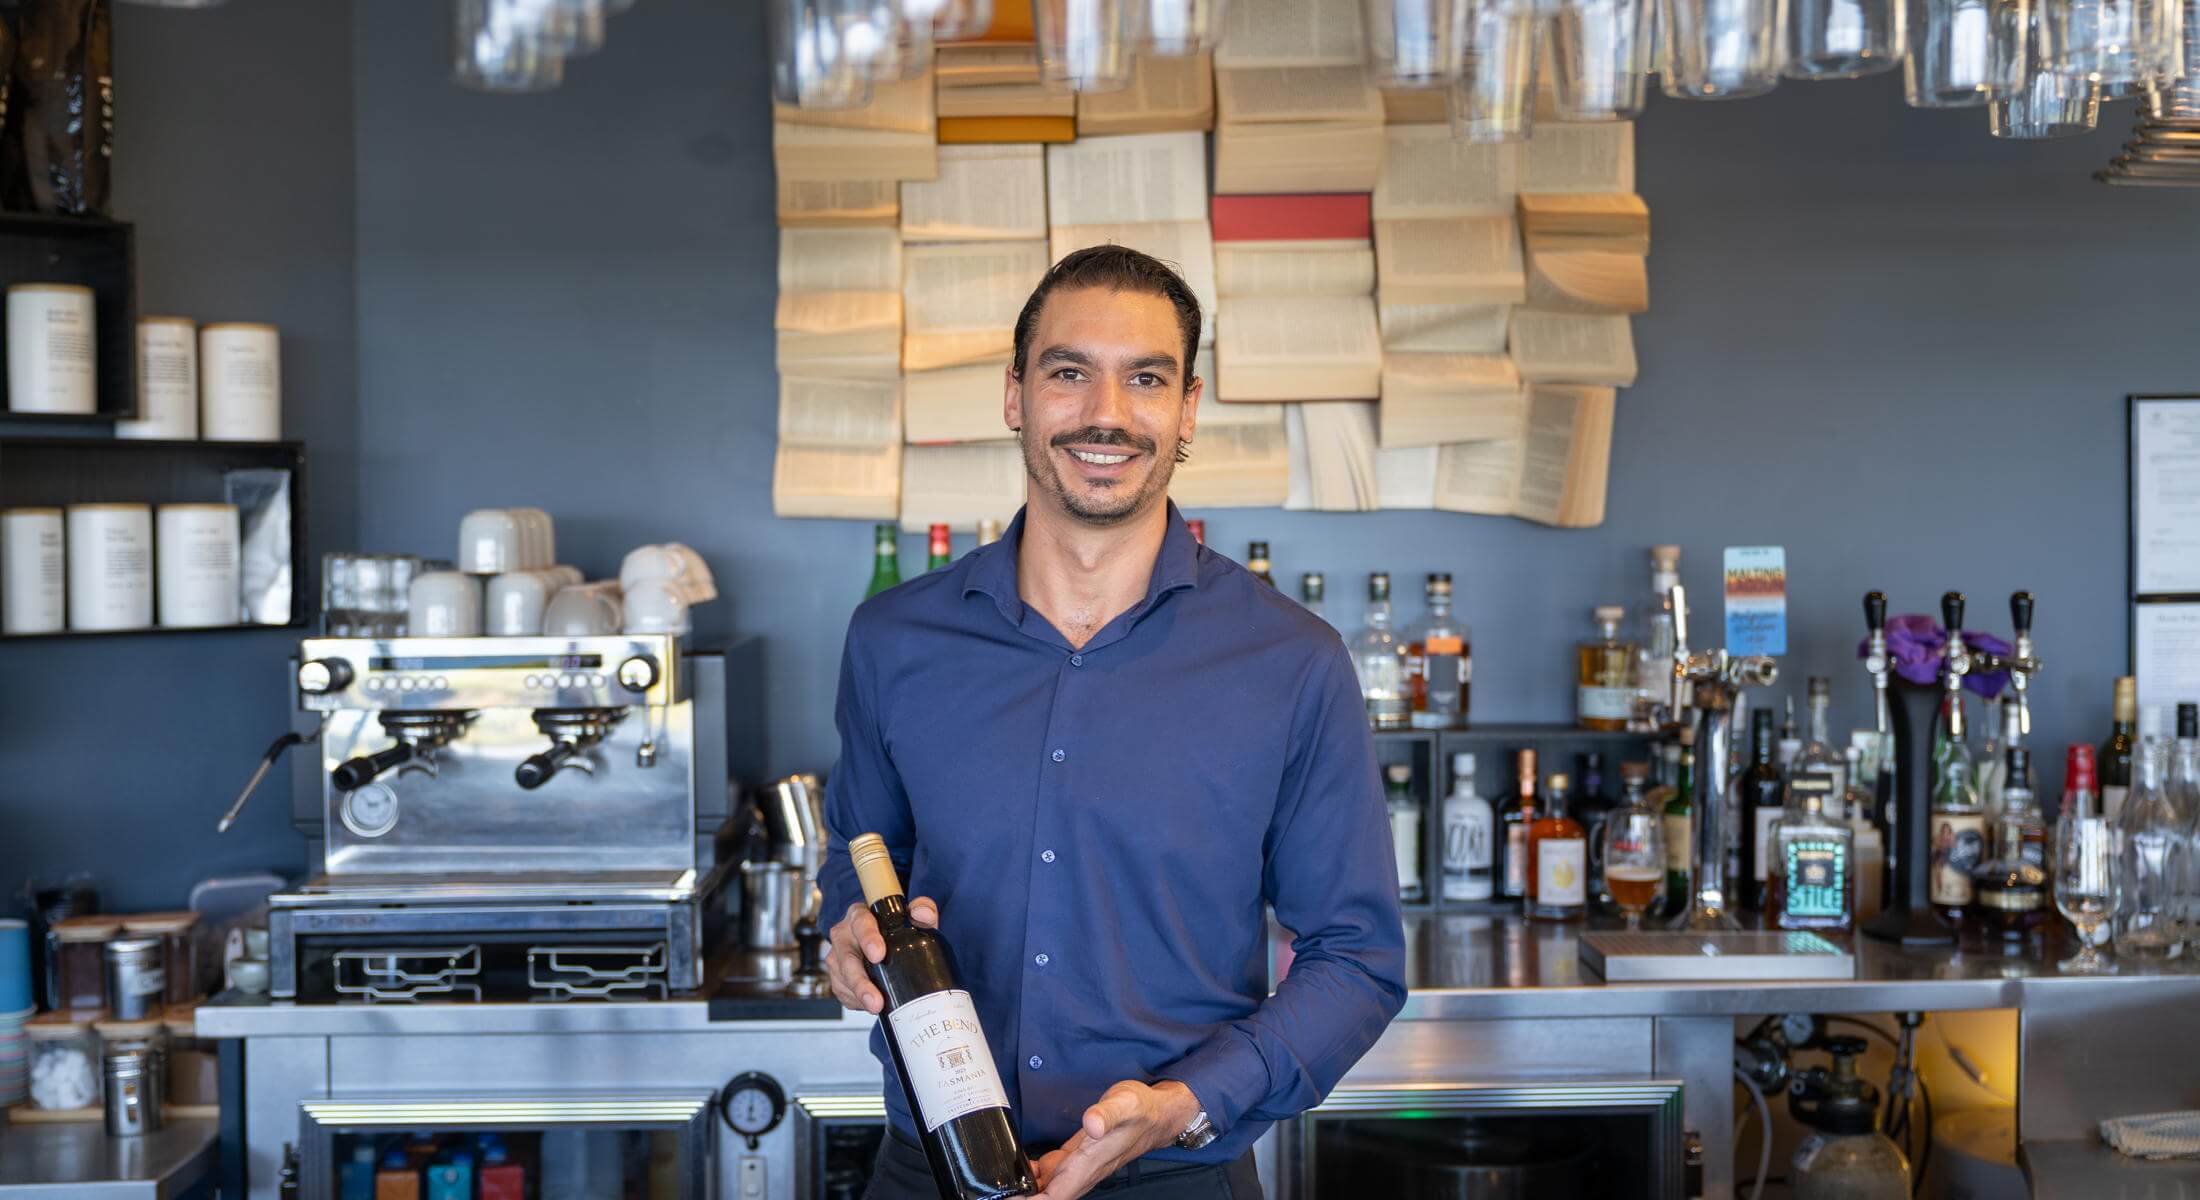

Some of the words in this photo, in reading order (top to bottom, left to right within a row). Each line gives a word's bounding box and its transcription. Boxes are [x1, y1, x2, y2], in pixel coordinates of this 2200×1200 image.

[911, 1023, 941, 1048] THE
[942, 1018, 979, 1035] BEND
[937, 1069, 987, 1089] TASMANIA
